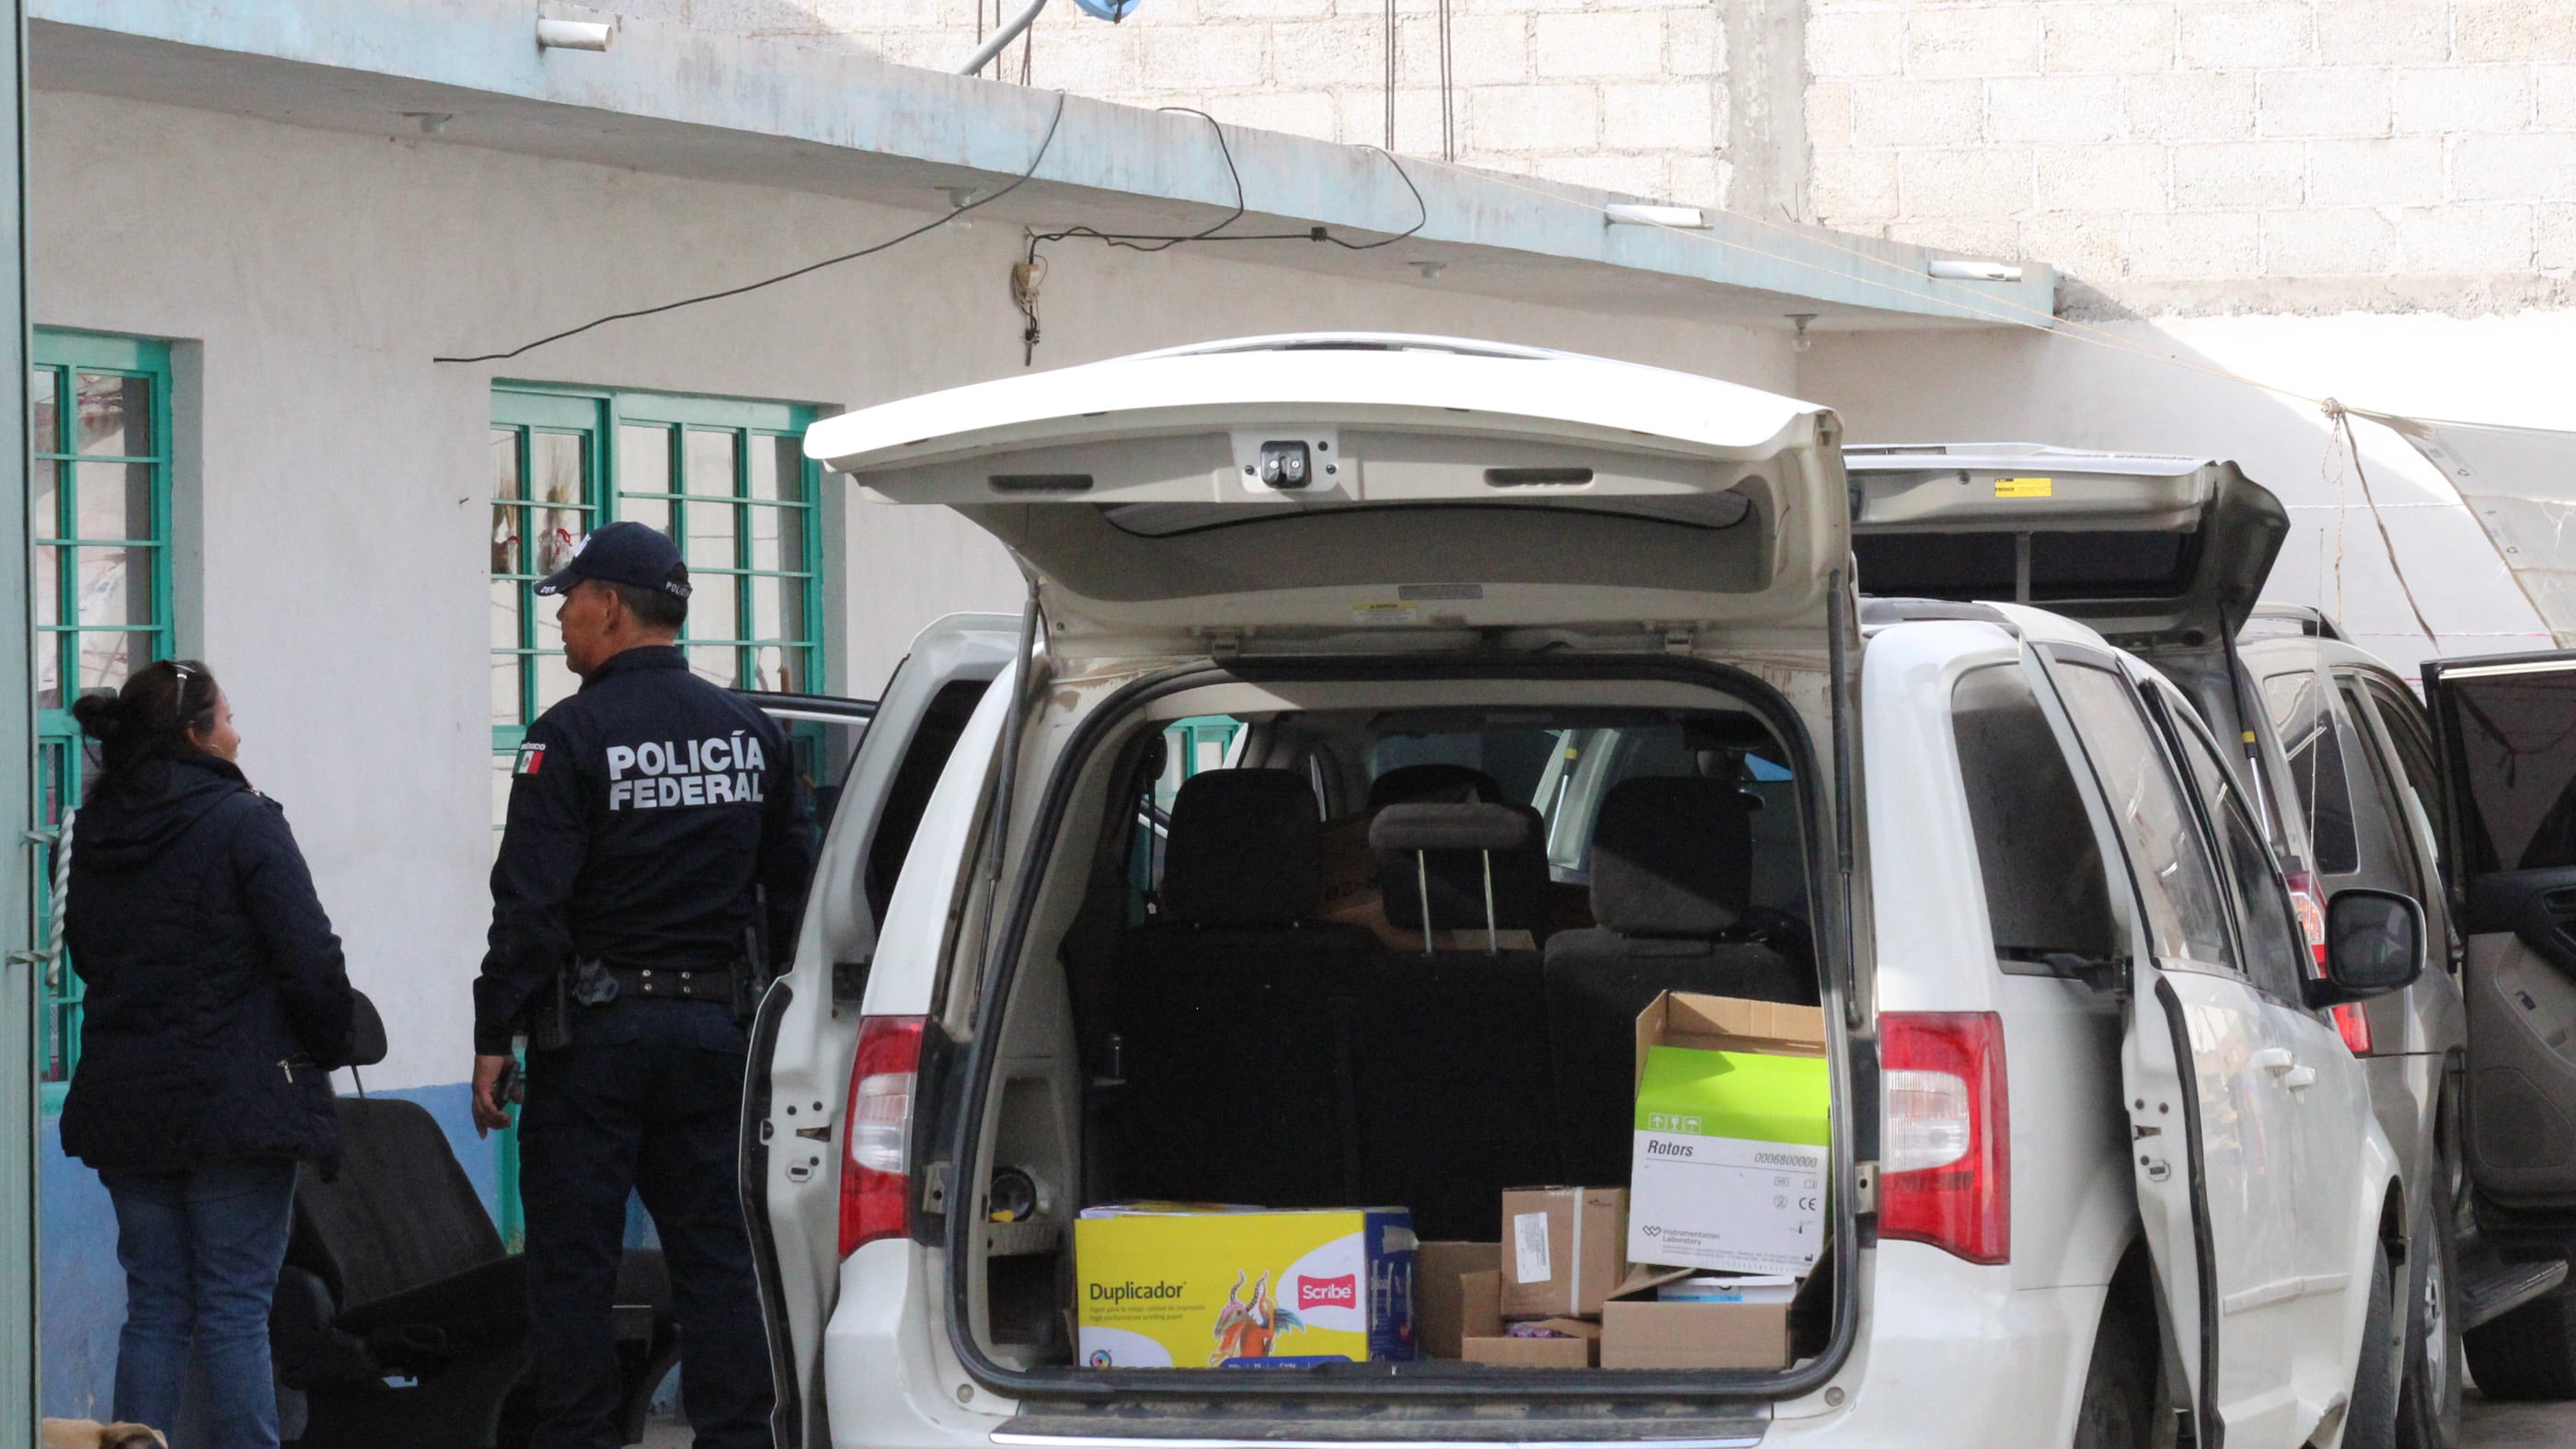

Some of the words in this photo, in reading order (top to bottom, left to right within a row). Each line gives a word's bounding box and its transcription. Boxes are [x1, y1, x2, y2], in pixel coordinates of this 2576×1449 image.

[606, 730, 766, 780] POLICÍA
[609, 772, 765, 811] FEDERAL
[1647, 1140, 1694, 1156] Rotors
[1754, 1152, 1818, 1168] 0006800000
[1663, 1229, 1720, 1239] Instrumentation
[1663, 1236, 1701, 1246] Laboratory
[1089, 1281, 1184, 1305] Duplicador
[1302, 1283, 1352, 1299] Scribe
